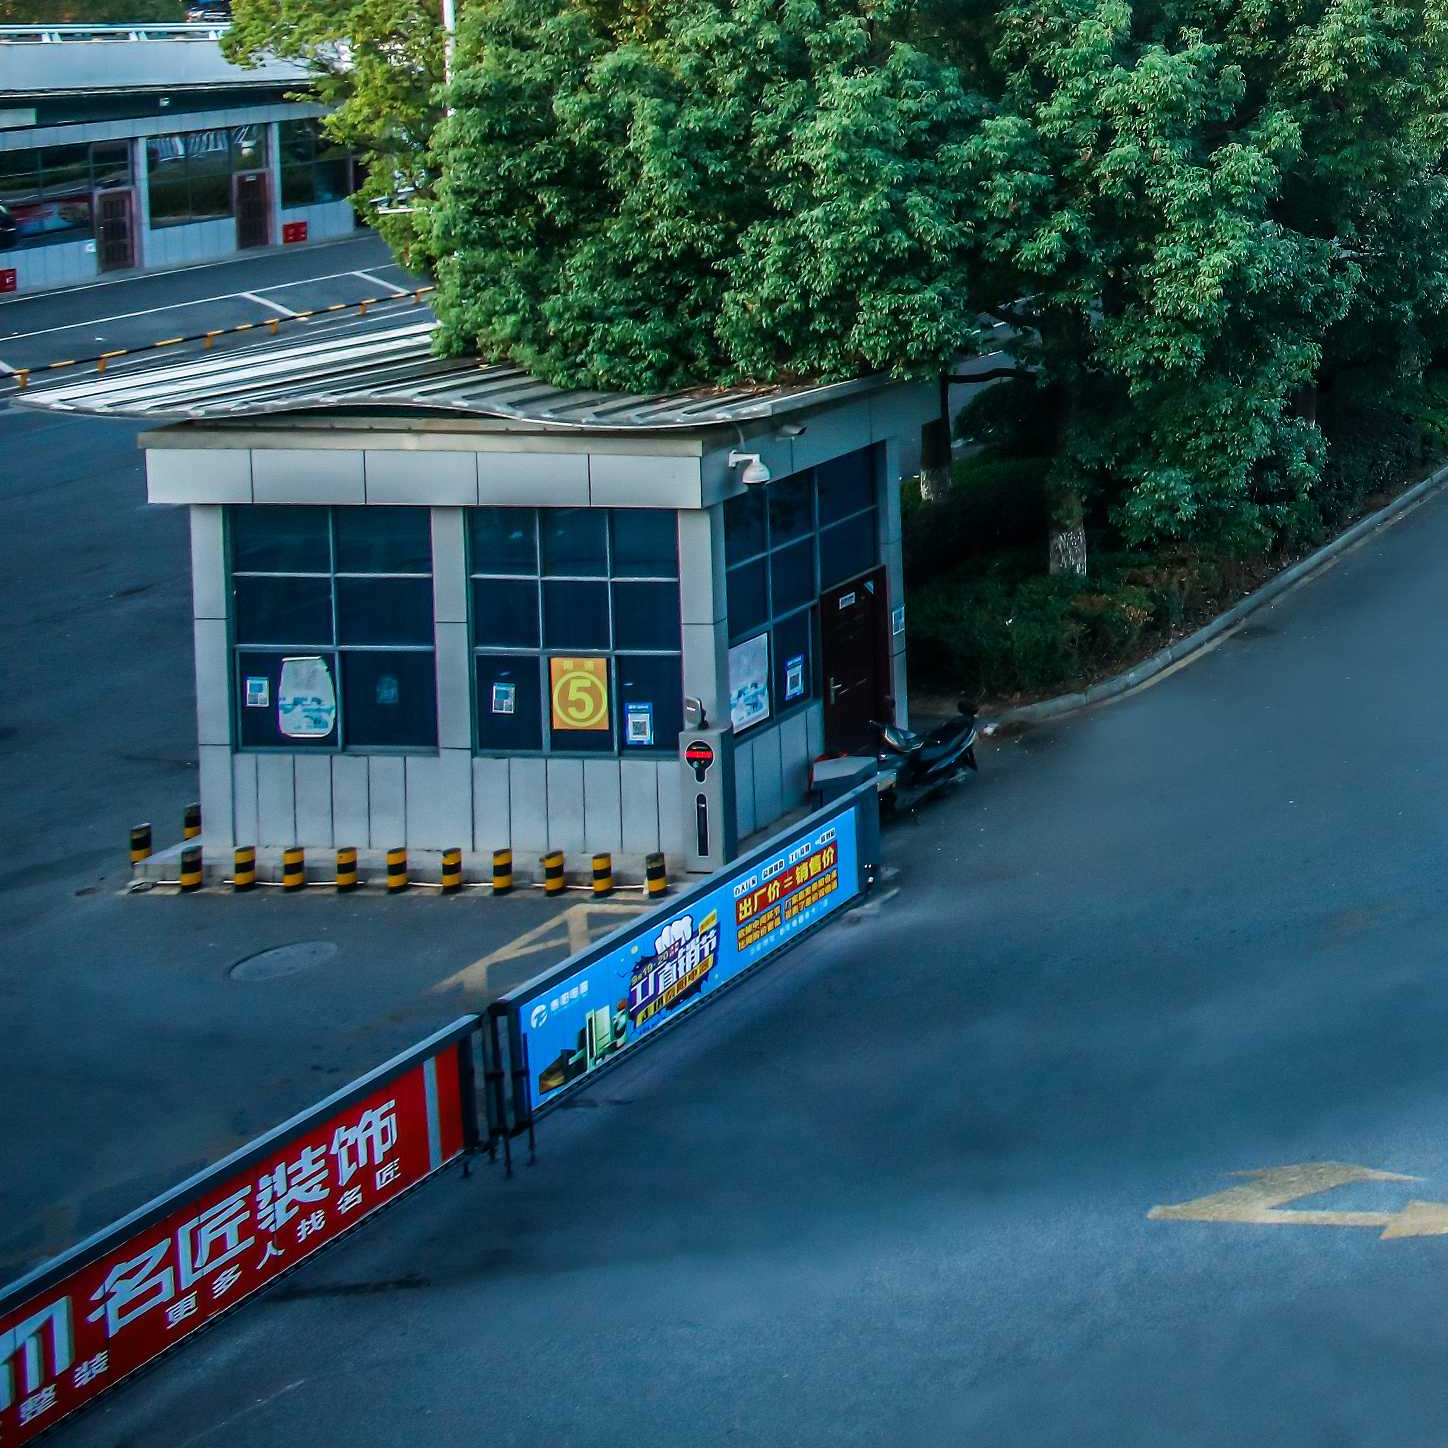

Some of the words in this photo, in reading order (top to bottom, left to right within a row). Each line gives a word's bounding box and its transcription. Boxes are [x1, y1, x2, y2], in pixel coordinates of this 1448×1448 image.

[567, 678, 594, 720] 5
[86, 1098, 398, 1339] 名匠装饰
[164, 1157, 403, 1331] 更多人找名匠
